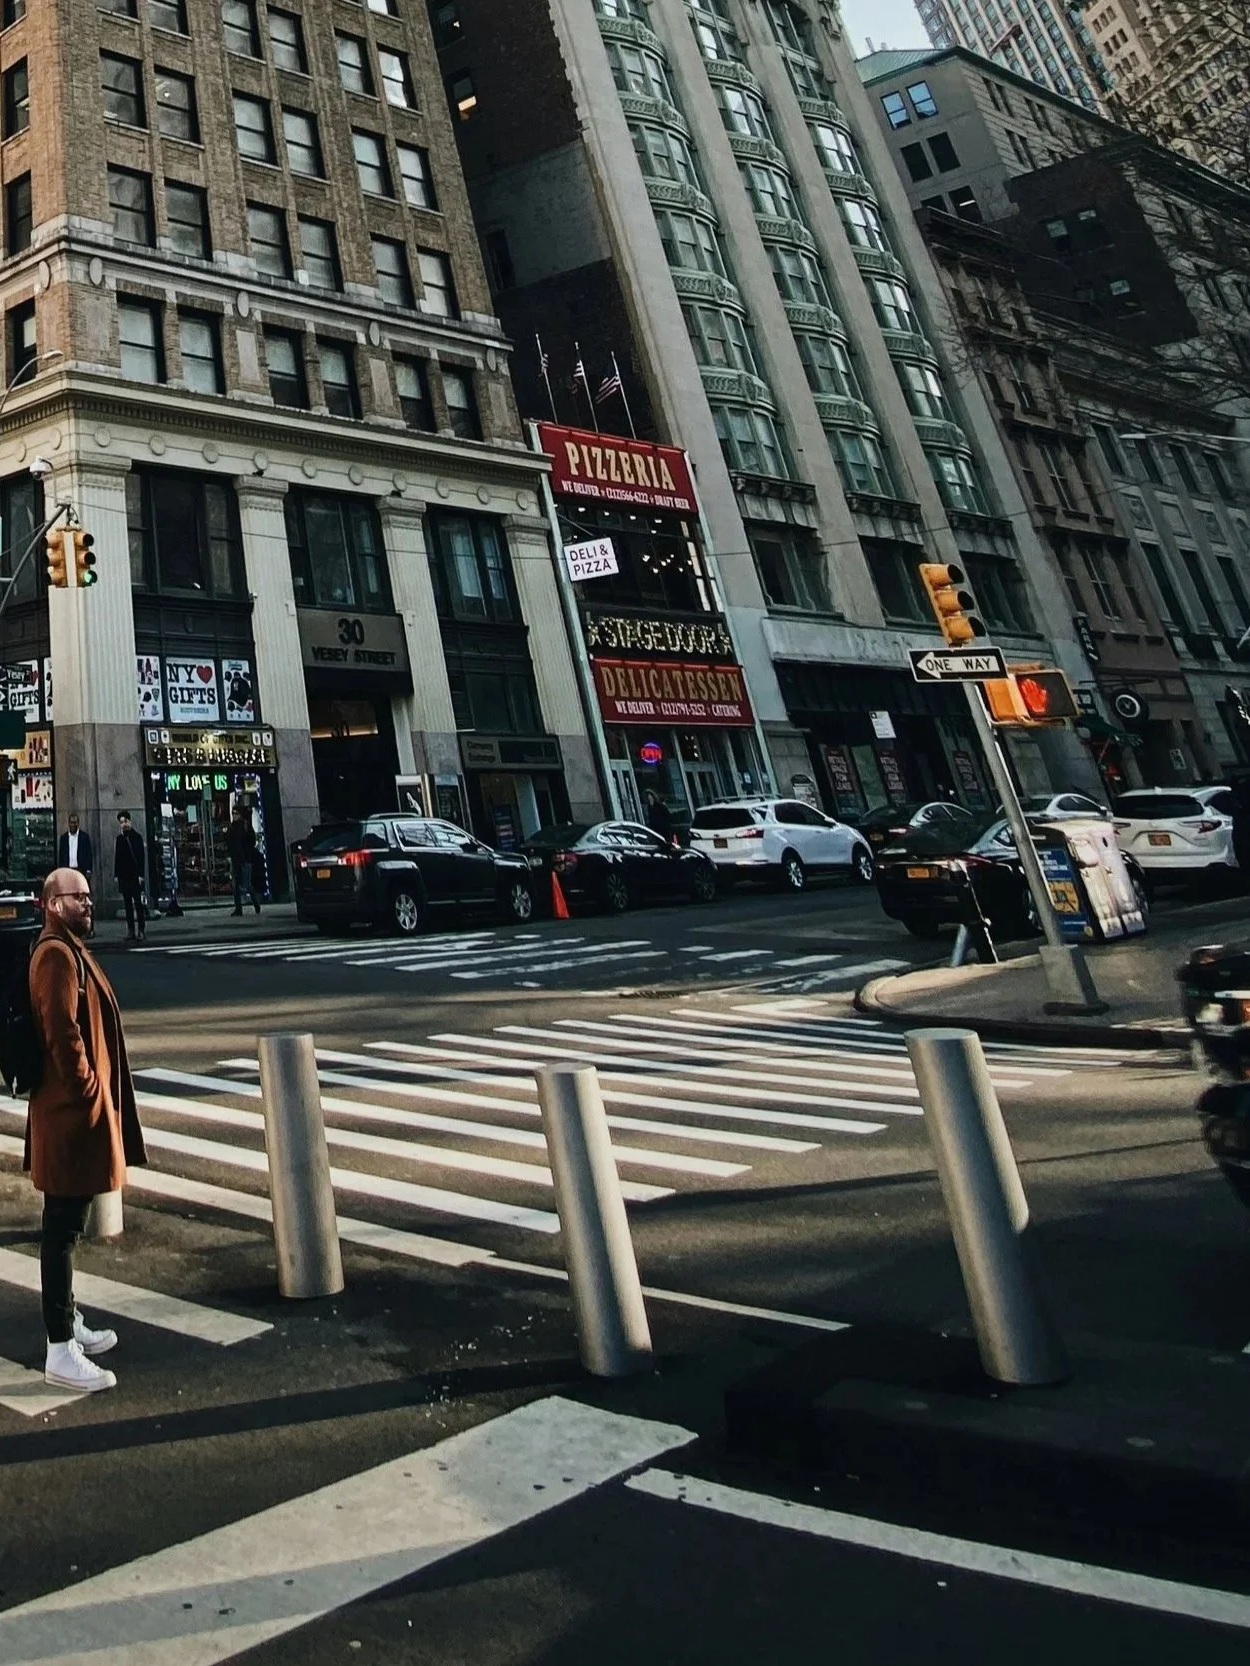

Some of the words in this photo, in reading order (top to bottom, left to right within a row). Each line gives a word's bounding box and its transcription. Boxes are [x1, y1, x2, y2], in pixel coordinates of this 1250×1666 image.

[564, 441, 676, 491] PIZZERIA
[561, 480, 573, 493] WE
[573, 481, 601, 498] DELIVER
[570, 546, 597, 561] DELI
[600, 544, 608, 556] &
[573, 558, 612, 576] PIZZA
[337, 618, 365, 646] 30
[602, 616, 666, 651] STAGE
[664, 621, 718, 654] DOOR
[311, 646, 348, 662] VESEY
[354, 649, 397, 665] STREET
[925, 658, 952, 671] ONE
[962, 657, 990, 670] WAY
[7, 669, 25, 681] Vesey
[166, 663, 197, 683] NY
[601, 666, 743, 701] DELICATESSEN
[10, 690, 40, 706] GIFTS
[169, 687, 216, 705] GIFTS
[614, 700, 628, 714] WE
[628, 701, 655, 716] DELIVER
[711, 703, 742, 718] CATERING
[640, 746, 662, 760] OPEN
[168, 774, 181, 790] NY
[185, 774, 211, 790] LOVE
[214, 774, 228, 790] US
